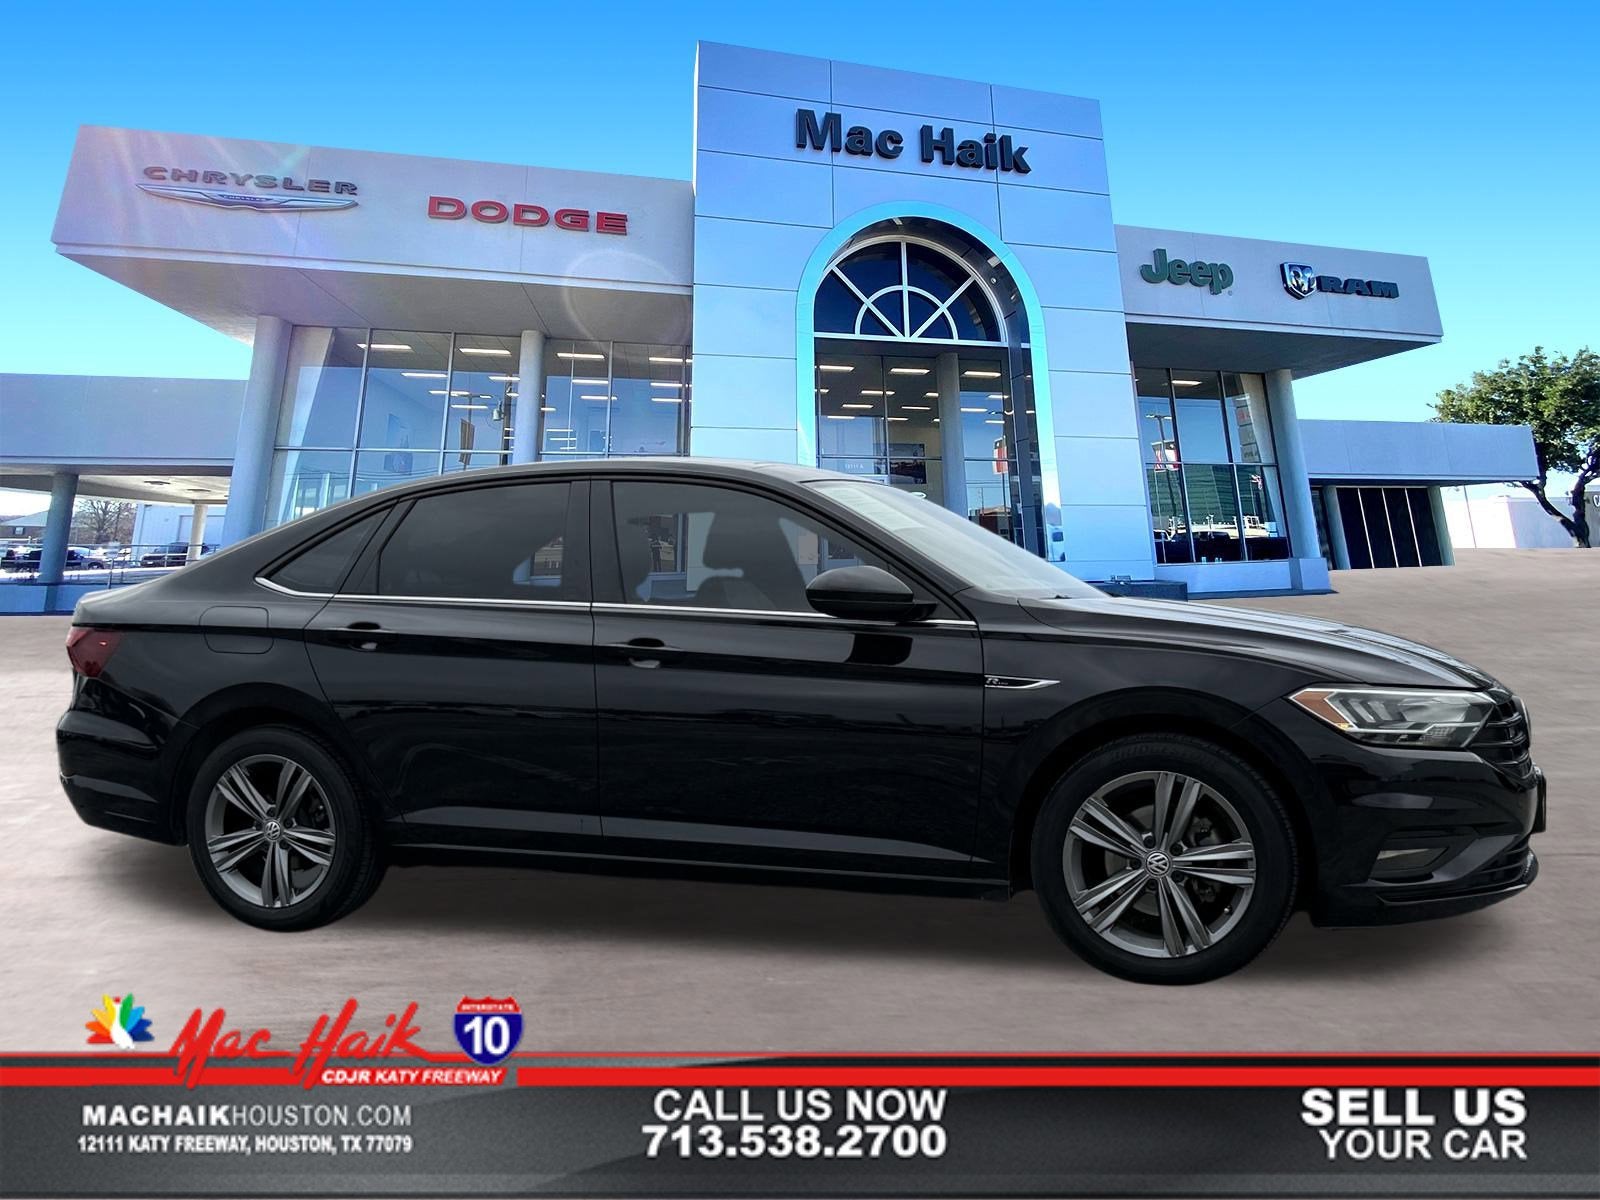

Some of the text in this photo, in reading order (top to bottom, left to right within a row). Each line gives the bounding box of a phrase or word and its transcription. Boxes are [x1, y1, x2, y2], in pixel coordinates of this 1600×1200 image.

[796, 108, 1032, 174] Mac Haik
[143, 166, 358, 196] CHRYSLER
[428, 196, 628, 236] DODGE
[1140, 248, 1234, 295] Jeep
[1316, 275, 1400, 299] RAM
